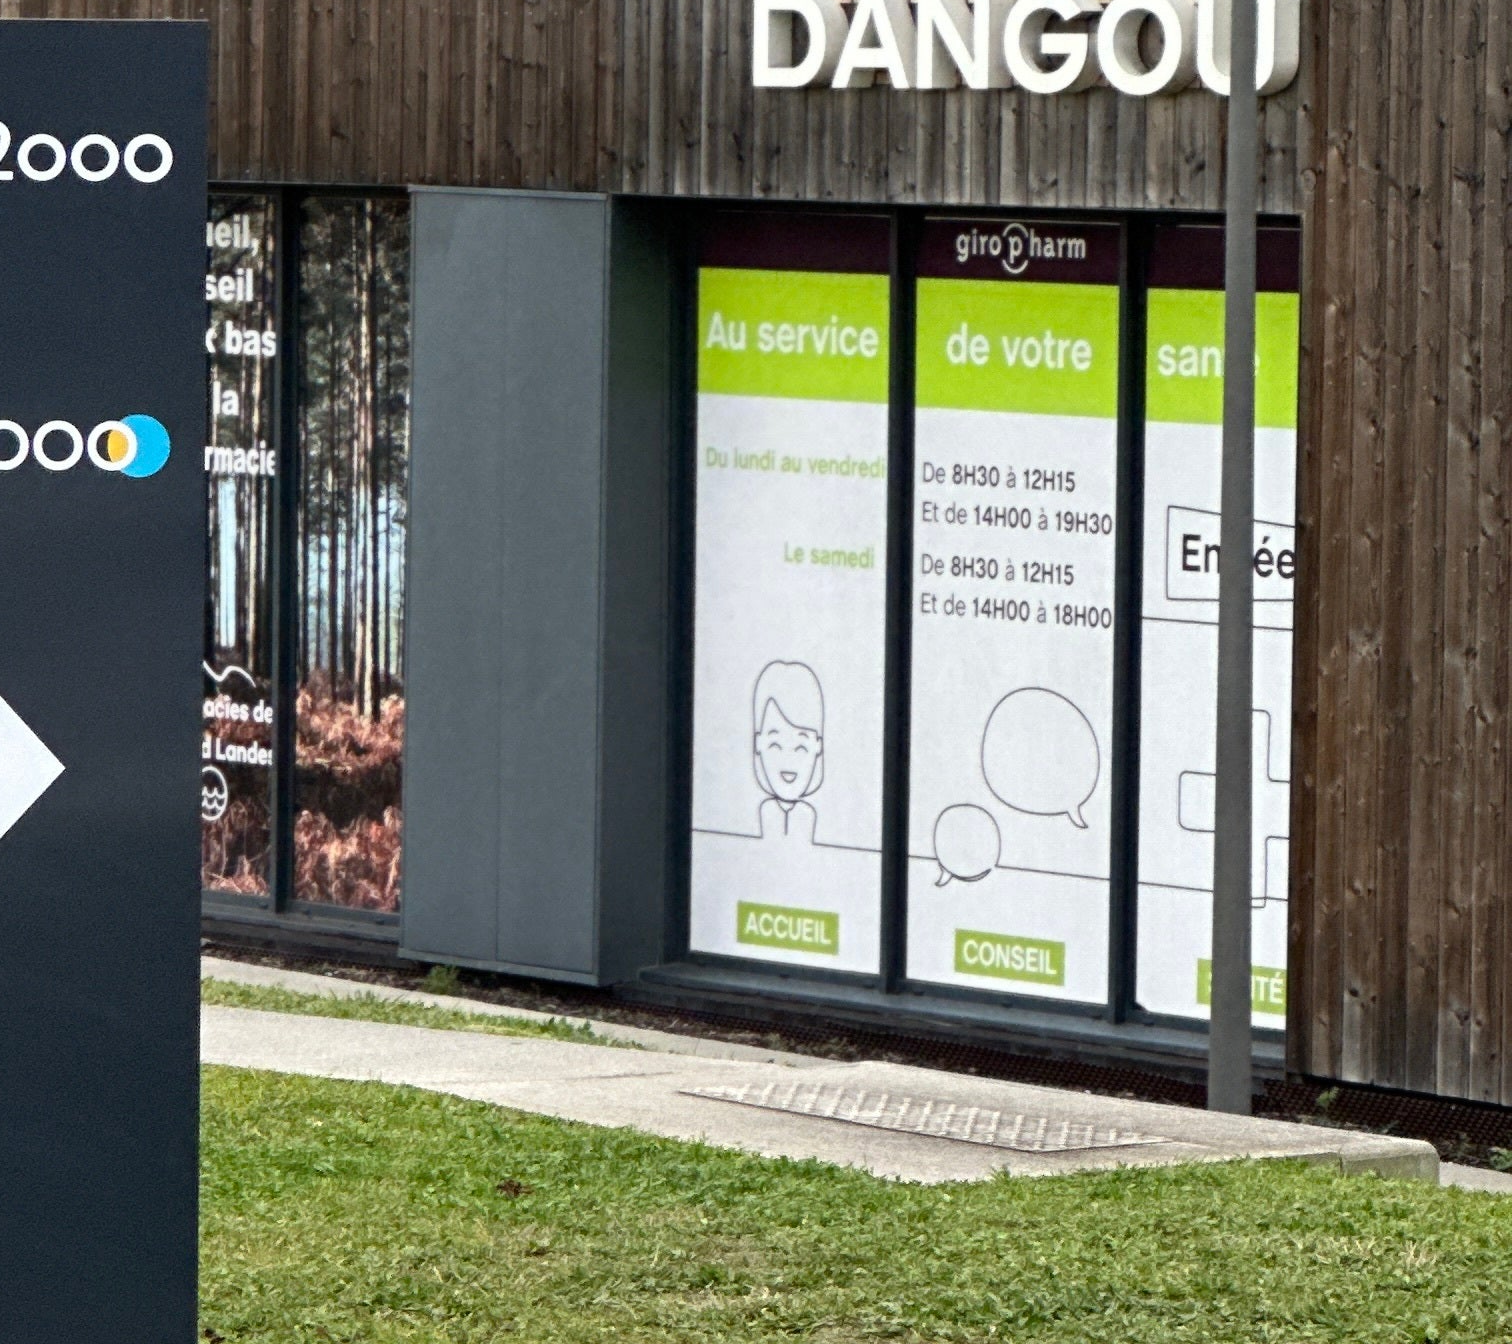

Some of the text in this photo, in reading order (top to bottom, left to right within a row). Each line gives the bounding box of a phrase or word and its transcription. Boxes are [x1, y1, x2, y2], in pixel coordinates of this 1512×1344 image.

[225, 319, 276, 356] bas
[706, 311, 879, 357] Au service
[946, 322, 1093, 371] de votre
[212, 381, 239, 416] la
[706, 447, 885, 479] Du lundi au vendredi
[922, 462, 1076, 492] De 8H30 à 12H15
[922, 501, 1113, 535] Et de 14H00 à 19H30
[783, 541, 875, 569] Le samedi
[921, 553, 1074, 585] De 8H30 à 12H15
[1181, 532, 1296, 579] Enée
[920, 593, 1112, 629] Et de 14H00 à 18H00
[744, 911, 832, 945] ACCUEIL
[963, 939, 1057, 976] CONSEIL
